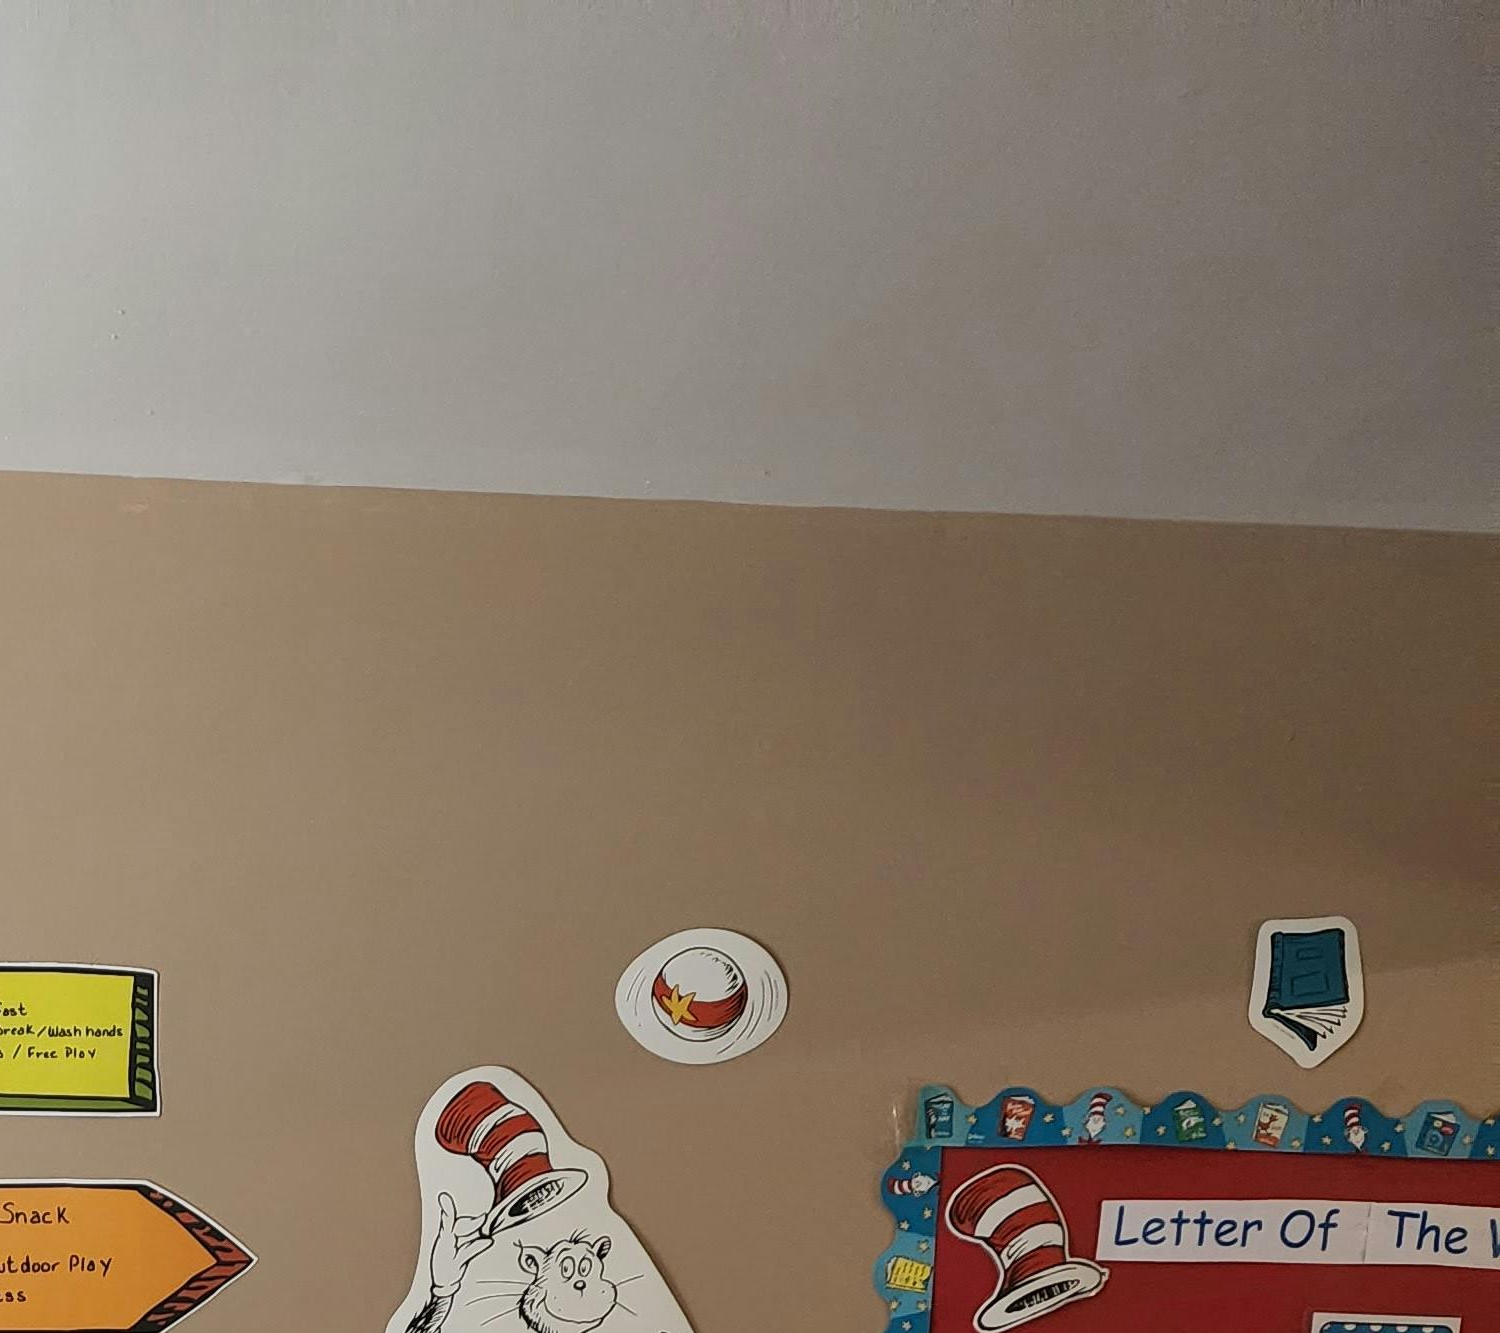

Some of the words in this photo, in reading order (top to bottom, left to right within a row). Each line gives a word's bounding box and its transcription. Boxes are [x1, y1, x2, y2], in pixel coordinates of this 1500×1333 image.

[27, 1046, 57, 1059] Free
[65, 1046, 96, 1060] Play
[1113, 1204, 1264, 1248] Letter
[1279, 1208, 1342, 1252] Of
[1386, 1209, 1469, 1255] The
[69, 1255, 112, 1278] Play
